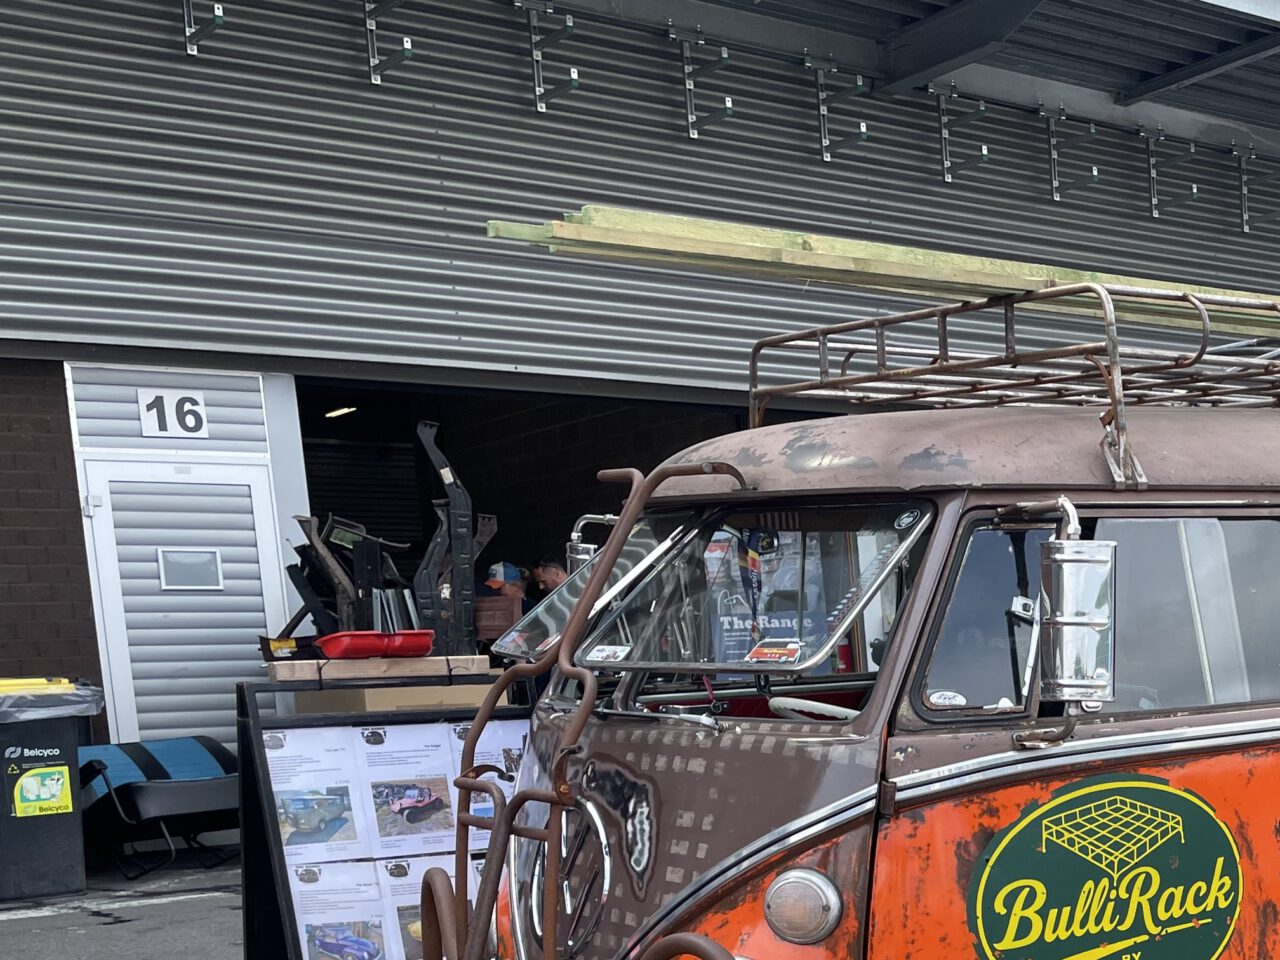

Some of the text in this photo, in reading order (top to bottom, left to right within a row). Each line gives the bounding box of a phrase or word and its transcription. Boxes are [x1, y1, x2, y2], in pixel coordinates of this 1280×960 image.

[146, 395, 204, 433] 16
[720, 615, 812, 630] The Range
[23, 748, 60, 757] Belcyco
[993, 856, 1235, 950] BulliRack
